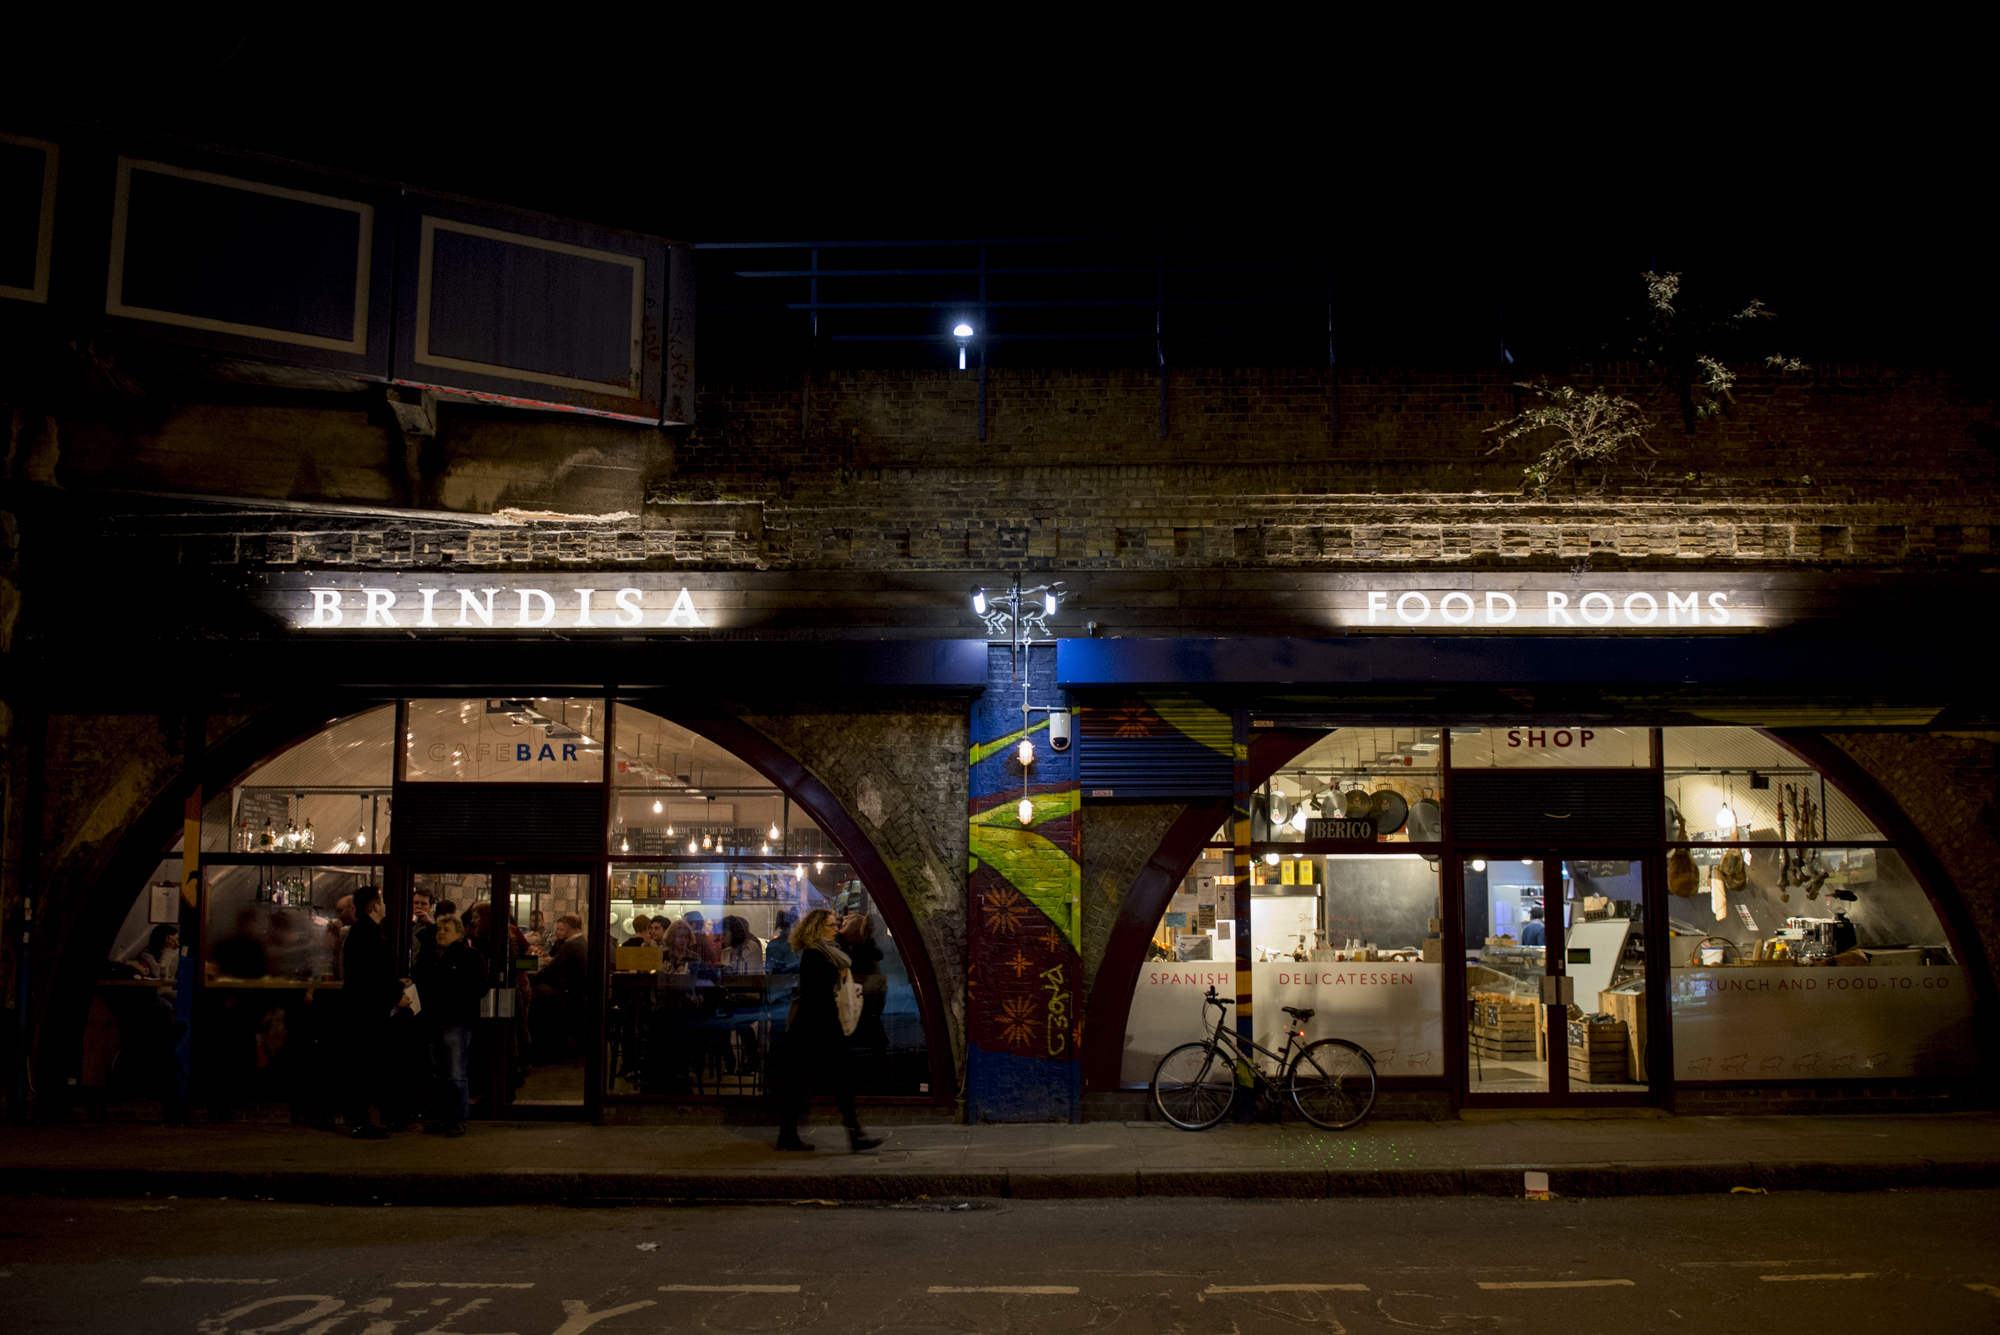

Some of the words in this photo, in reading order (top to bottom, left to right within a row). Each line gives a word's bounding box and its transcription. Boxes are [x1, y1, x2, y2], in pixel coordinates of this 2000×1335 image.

[309, 587, 702, 628] BRINDISA
[1367, 591, 1517, 625] FOOD
[1546, 591, 1731, 625] ROOMS
[1507, 730, 1595, 748] SHOP
[516, 743, 578, 762] BAR
[1150, 973, 1229, 985] SPANISH
[1279, 972, 1414, 985] DELICATESSEN
[1777, 979, 1817, 990] AND
[1827, 977, 1949, 990] FOOD-TO-GO
